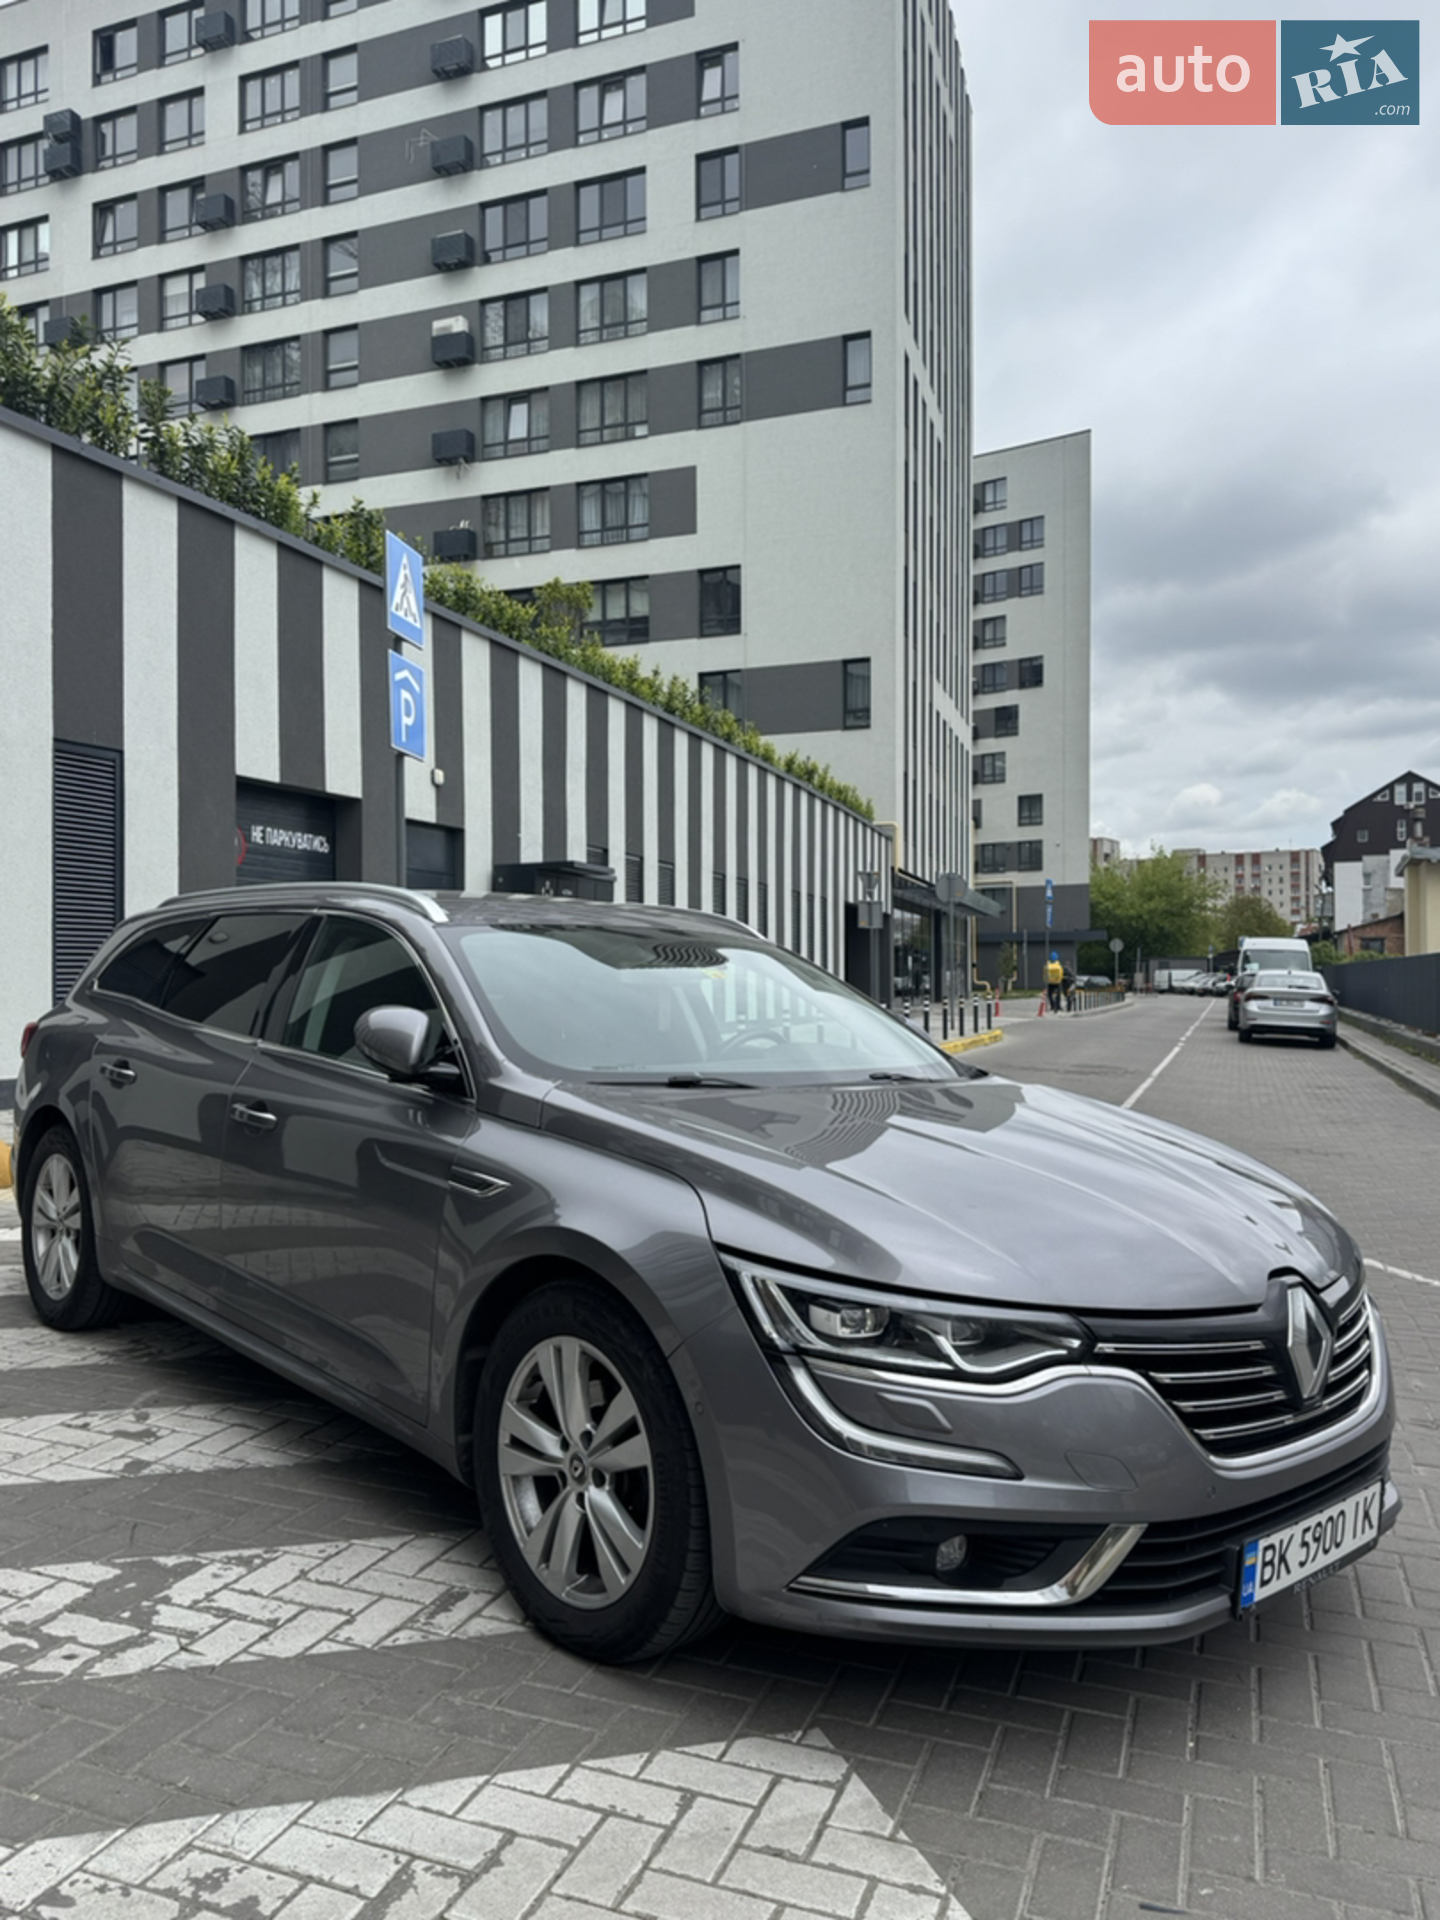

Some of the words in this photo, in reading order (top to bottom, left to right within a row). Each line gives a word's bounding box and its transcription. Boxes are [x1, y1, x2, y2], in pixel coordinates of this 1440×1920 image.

[400, 688, 416, 743] P
[251, 824, 264, 844] НЕ
[265, 826, 330, 853] ПАРКУВАТИСЬ
[1259, 1533, 1294, 1588] BK
[1298, 1509, 1346, 1568] 5900
[1352, 1491, 1376, 1540] IK
